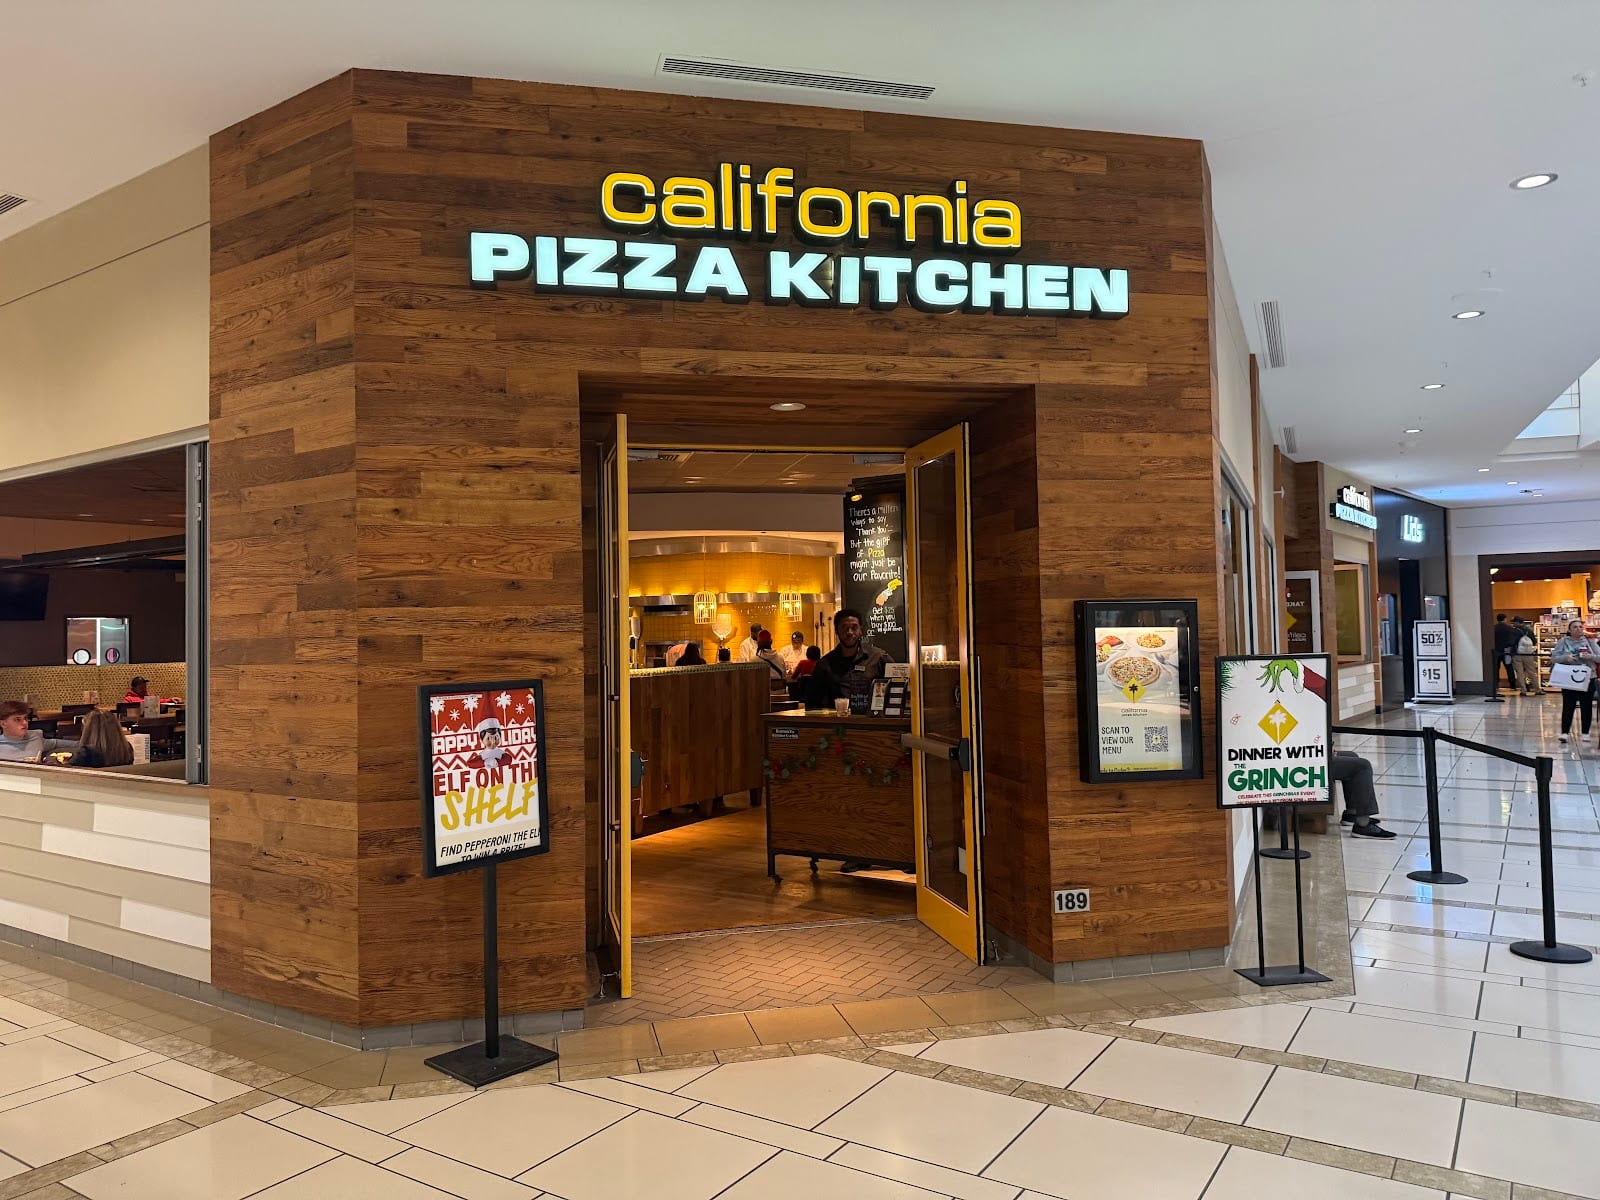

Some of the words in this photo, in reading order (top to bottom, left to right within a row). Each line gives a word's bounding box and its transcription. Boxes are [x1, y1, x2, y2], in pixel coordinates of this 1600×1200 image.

[601, 163, 1022, 248] california
[470, 231, 748, 296] PIZZA
[770, 251, 1129, 313] KITCHEN
[863, 538, 874, 547] the
[850, 559, 869, 573] might
[871, 558, 885, 569] just
[887, 557, 896, 567] be
[853, 572, 868, 581] our
[1422, 668, 1441, 680] $15
[1101, 726, 1120, 735] SCAN
[1121, 726, 1130, 734] TO
[433, 735, 478, 754] APPY
[1101, 736, 1119, 745] VIEW
[1120, 736, 1134, 744] OUR
[1102, 746, 1122, 755] MENU
[1228, 748, 1281, 761] DINNER
[1286, 745, 1324, 758] WITH
[434, 771, 470, 796] ELF
[475, 766, 504, 789] ON
[1228, 766, 1326, 791] GRINCH
[441, 777, 538, 831] SHELF
[440, 844, 463, 858] FIND
[464, 833, 512, 853] PEPPERONI
[513, 829, 529, 843] THE
[1056, 892, 1088, 911] 189
